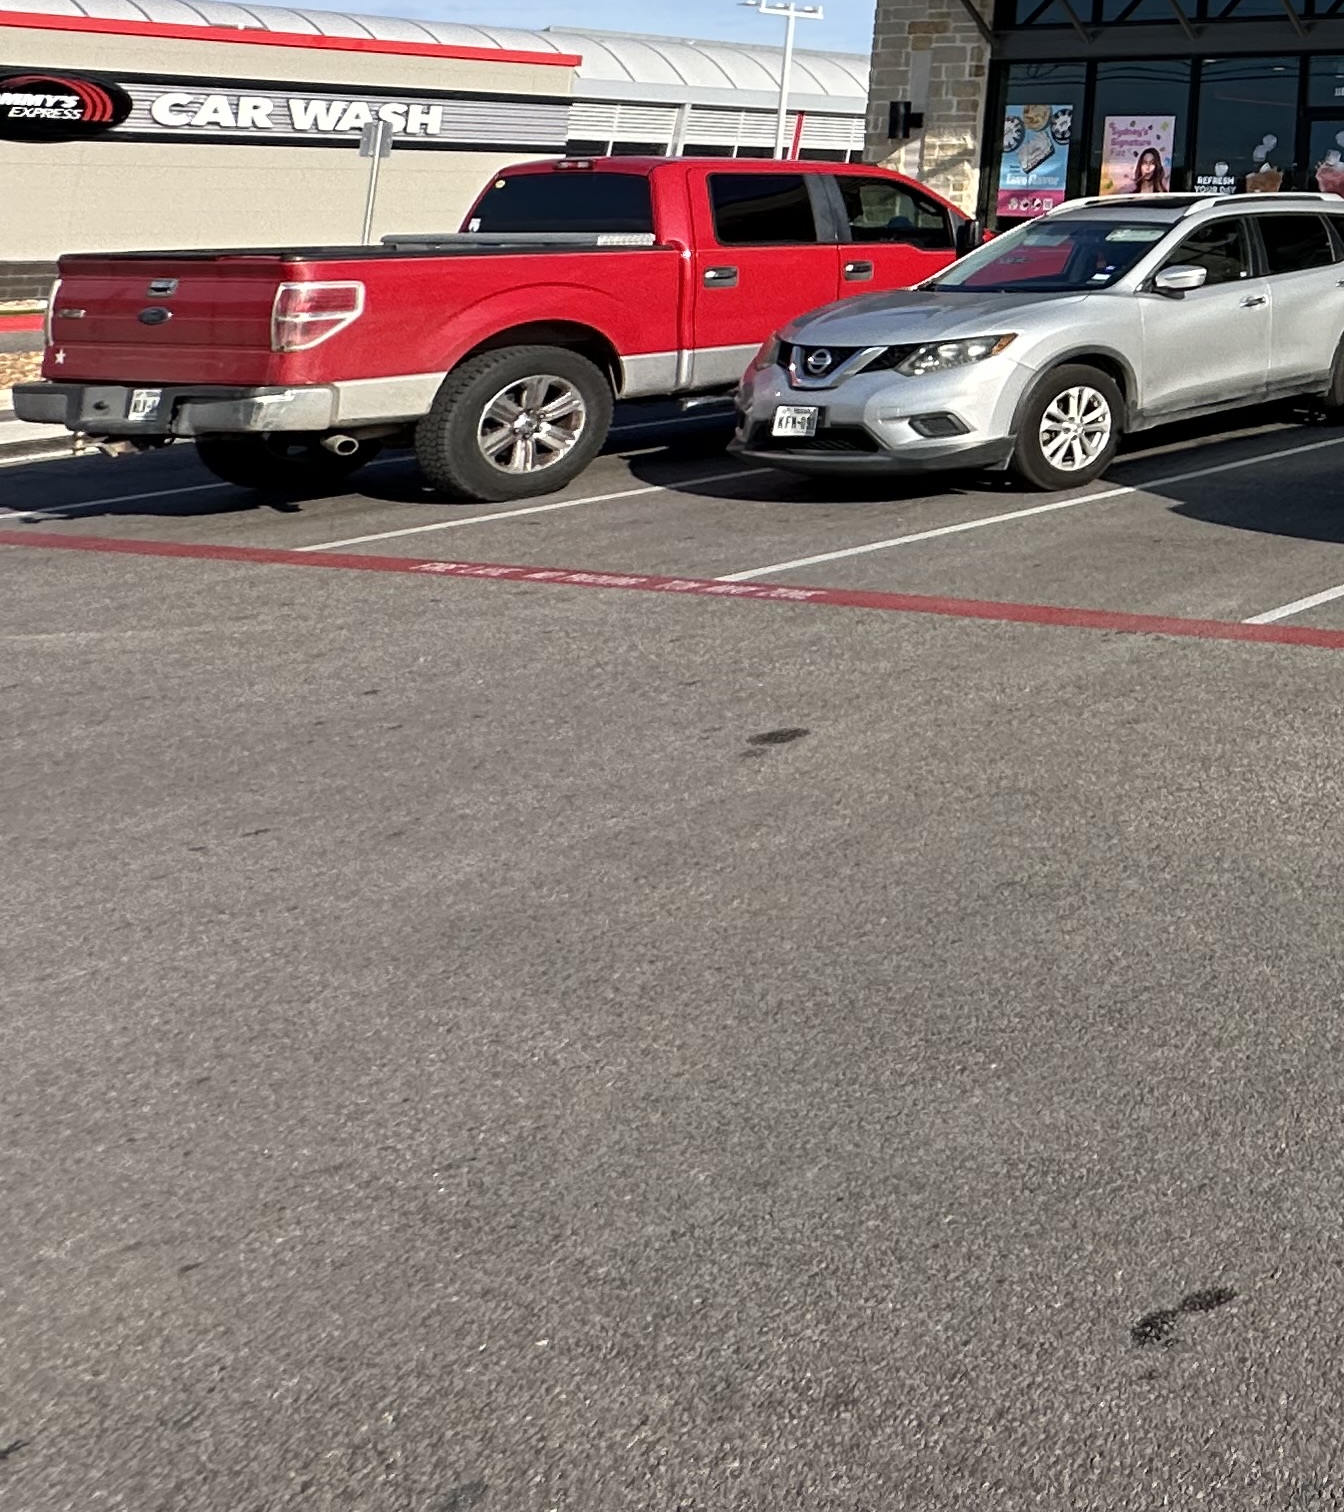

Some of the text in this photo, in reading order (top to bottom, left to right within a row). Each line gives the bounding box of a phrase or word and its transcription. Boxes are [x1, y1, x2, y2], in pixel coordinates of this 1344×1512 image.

[8, 106, 83, 120] EXPRESS
[151, 92, 443, 135] CAR WASH
